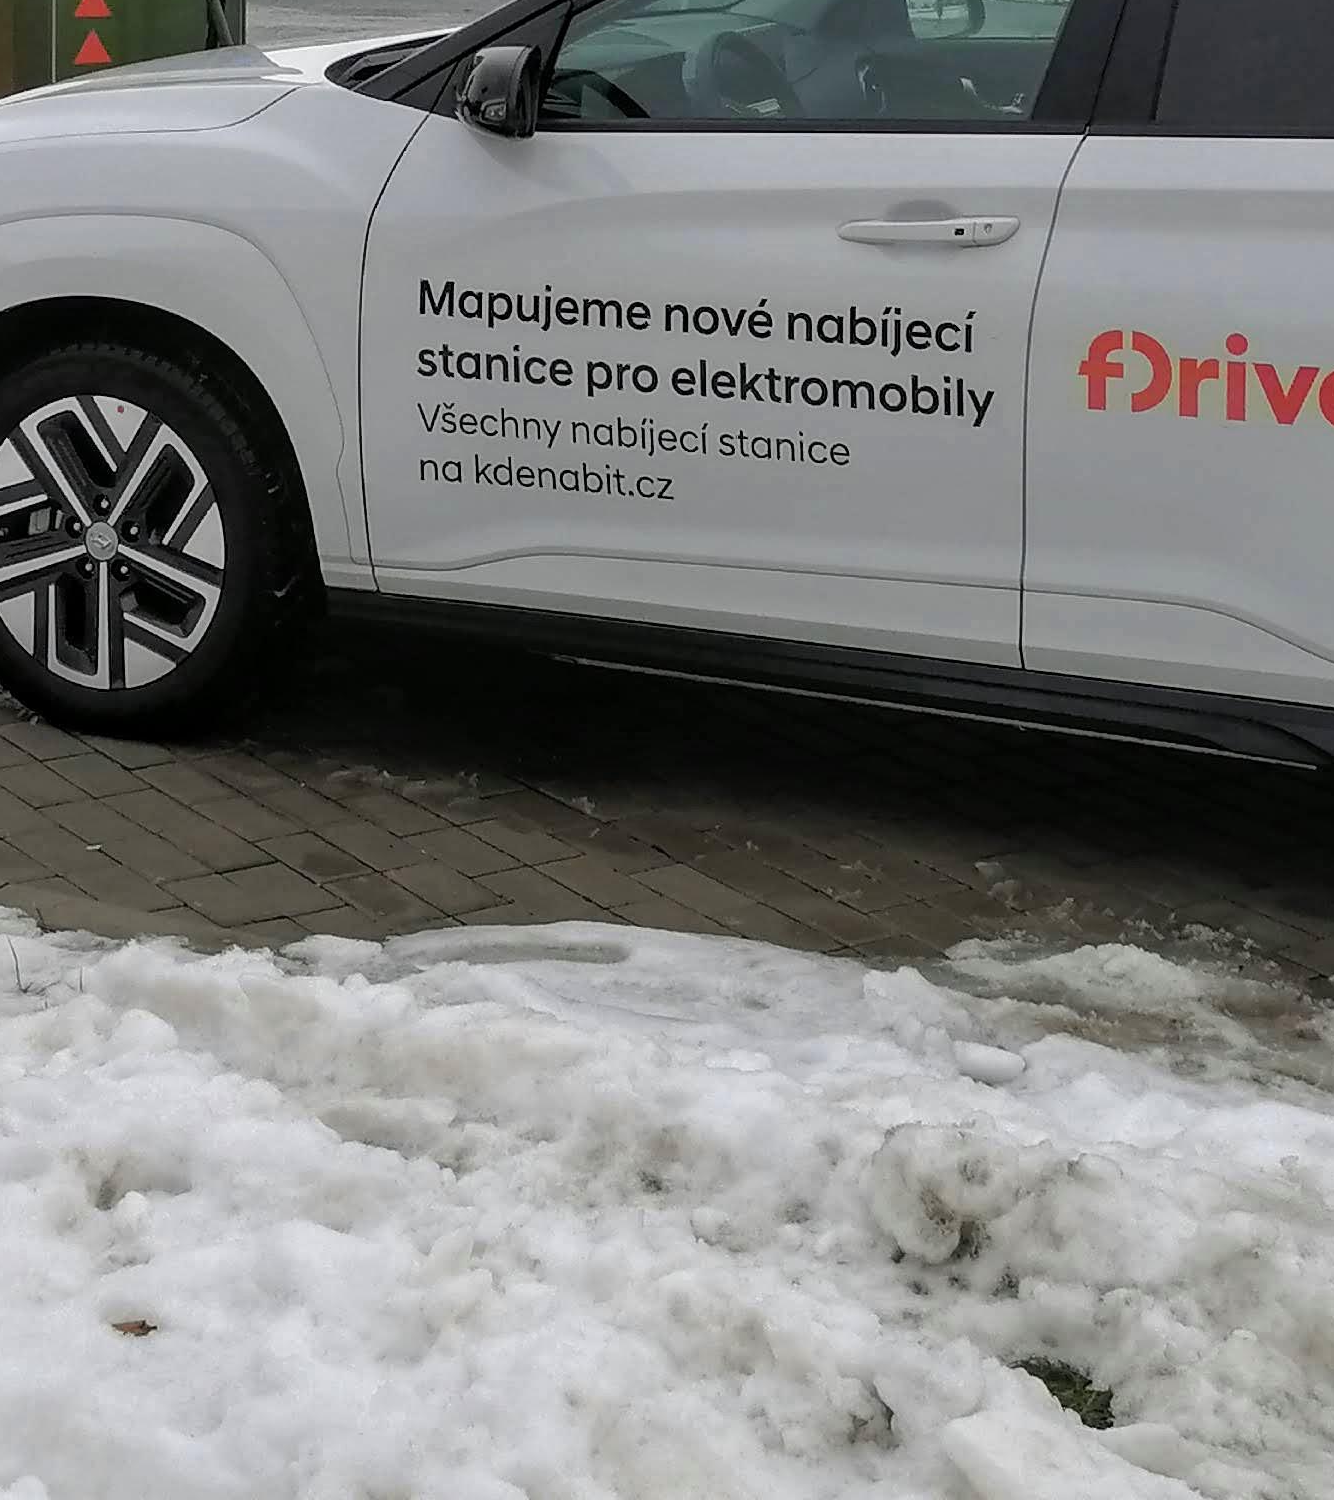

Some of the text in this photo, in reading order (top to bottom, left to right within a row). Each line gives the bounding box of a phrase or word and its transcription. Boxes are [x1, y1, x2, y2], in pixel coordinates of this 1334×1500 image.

[419, 279, 977, 357] Mapujeme nové nabíjecí
[417, 344, 995, 427] stanice pro elektromobily
[417, 402, 851, 466] Všechny nabíjecí stanice
[419, 453, 675, 500] na kdenabit.cz
